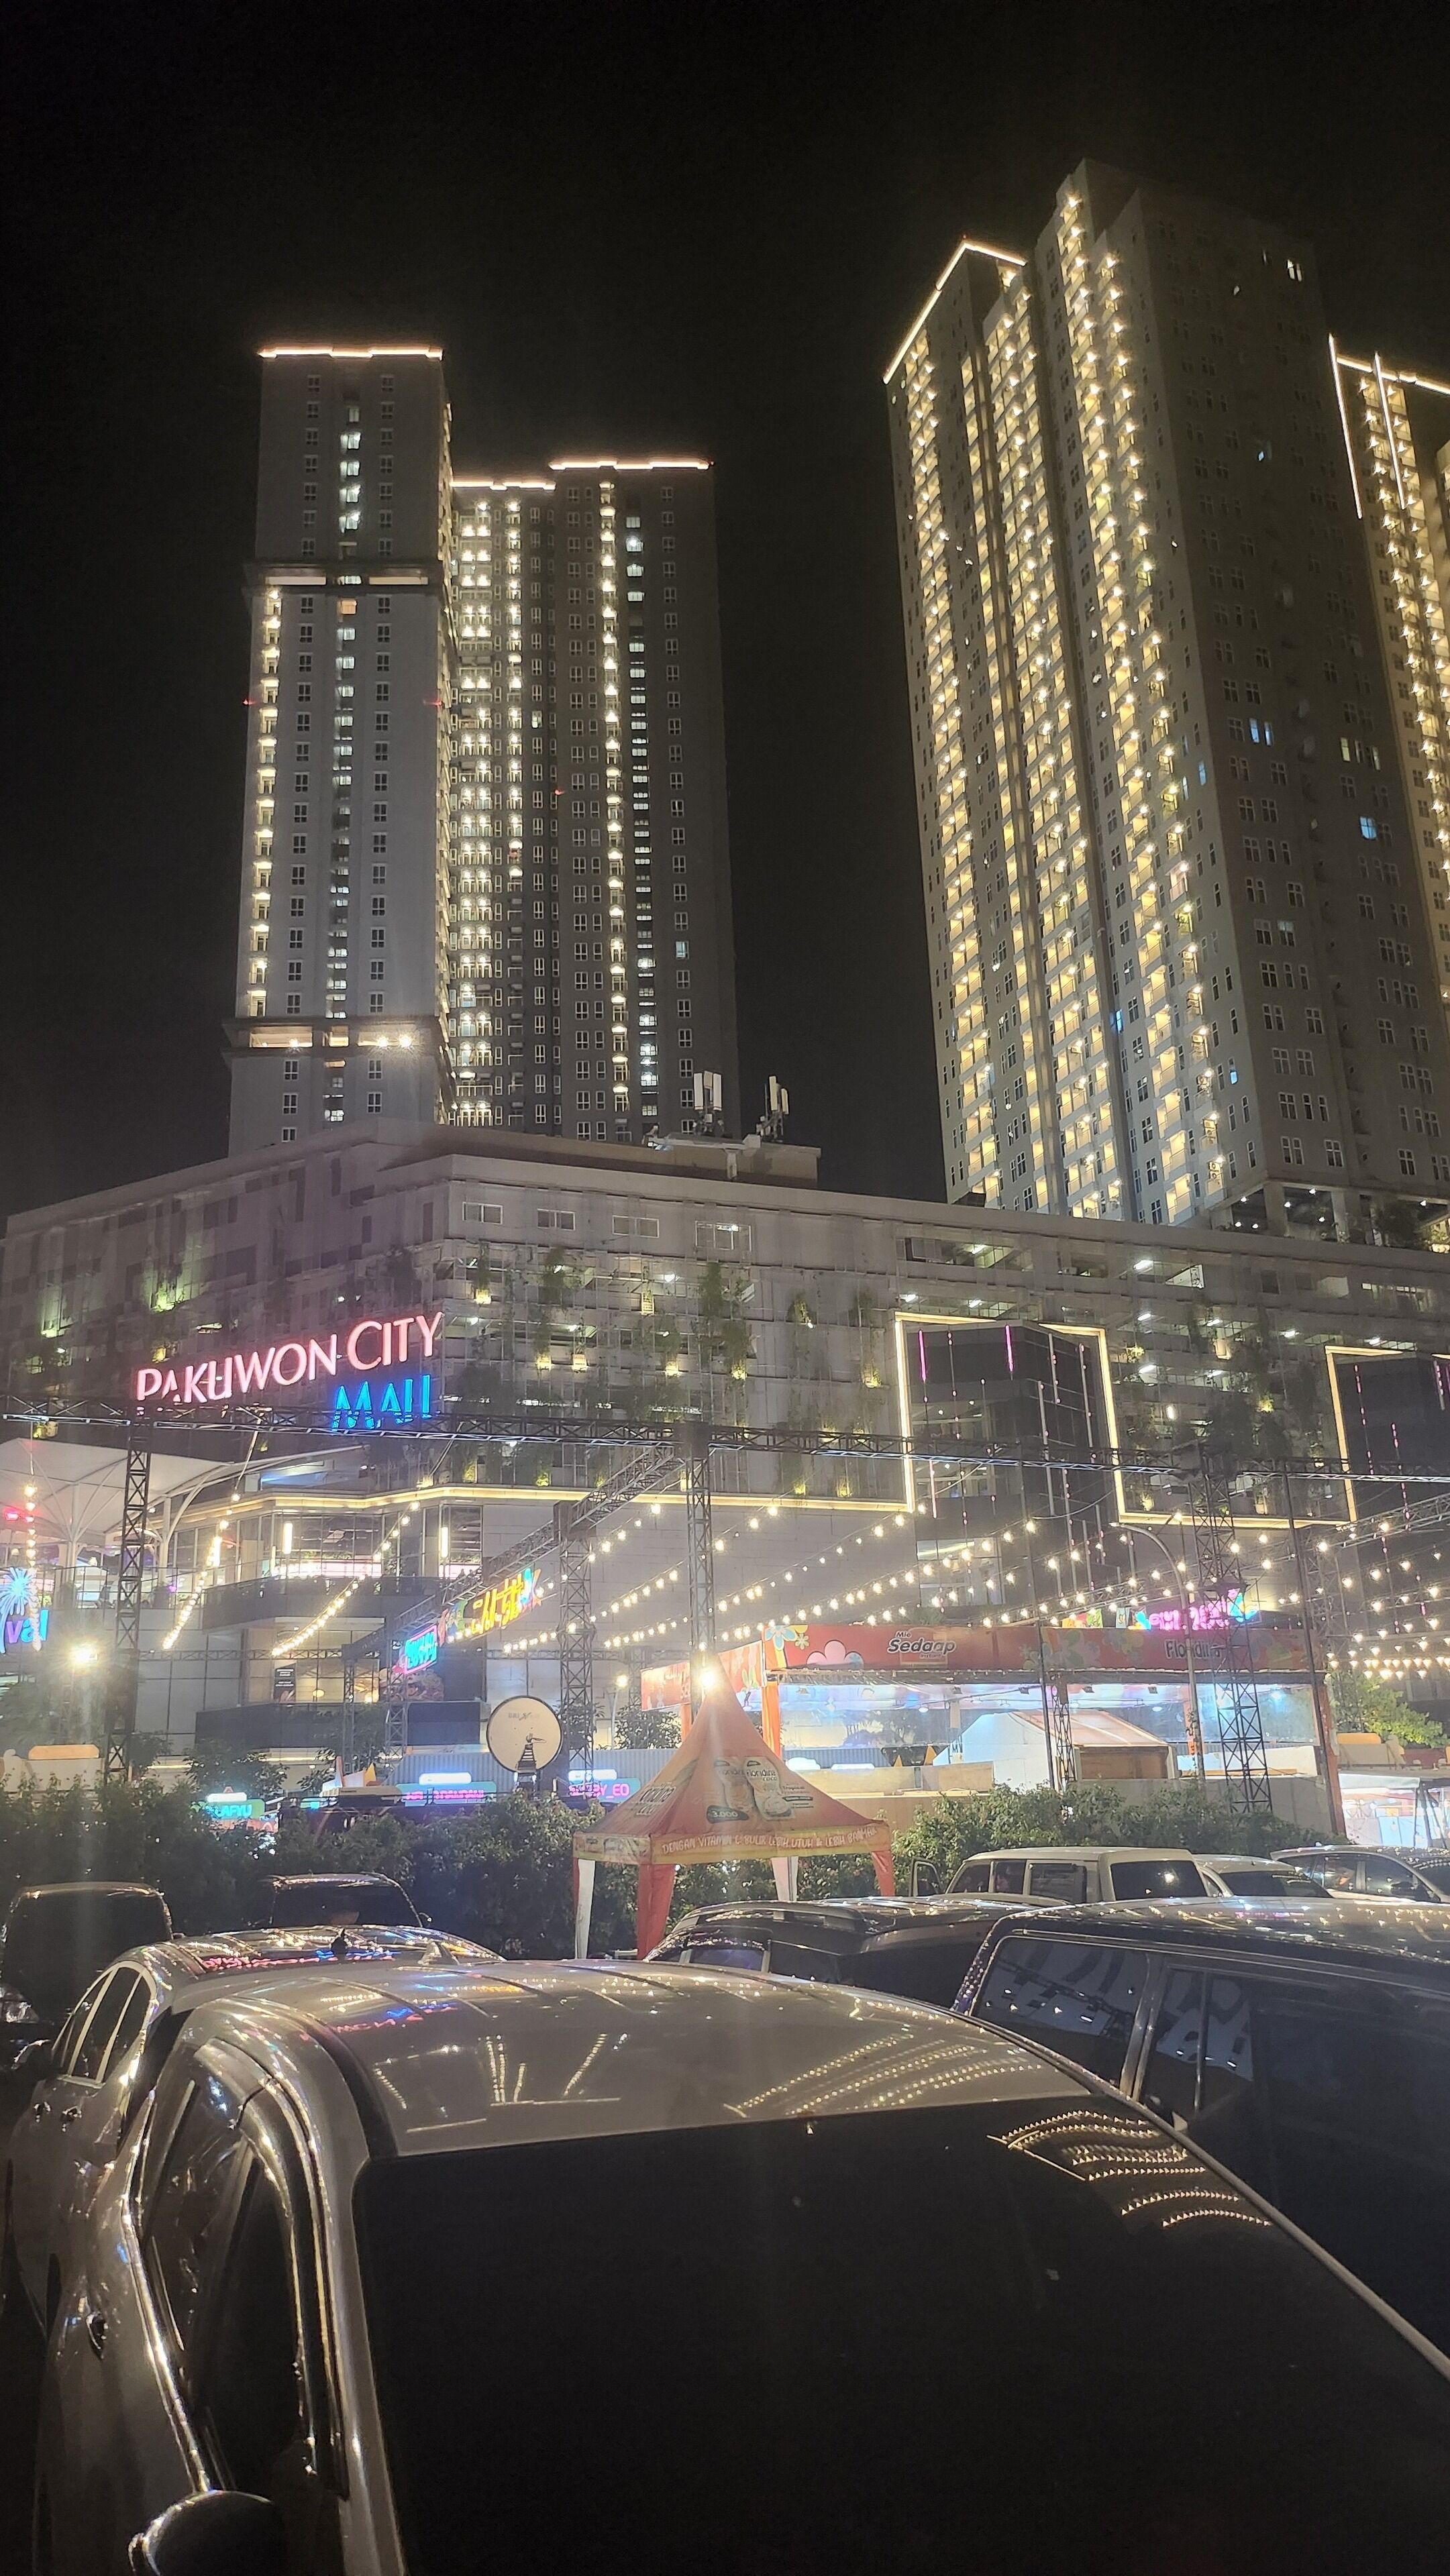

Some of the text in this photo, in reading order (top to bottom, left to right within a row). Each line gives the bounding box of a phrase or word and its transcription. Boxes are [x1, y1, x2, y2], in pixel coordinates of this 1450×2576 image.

[137, 1311, 445, 1405] PAKUWON CITY
[887, 1638, 957, 1656] Sedaap
[662, 1837, 696, 1854] DENGAN
[697, 1835, 731, 1847] VITAMIN
[743, 1835, 766, 1845] BULIR
[769, 1835, 789, 1846] LEBIH
[791, 1838, 814, 1848] UTUH
[815, 1837, 823, 1847] &
[825, 1835, 845, 1847] LEBIH
